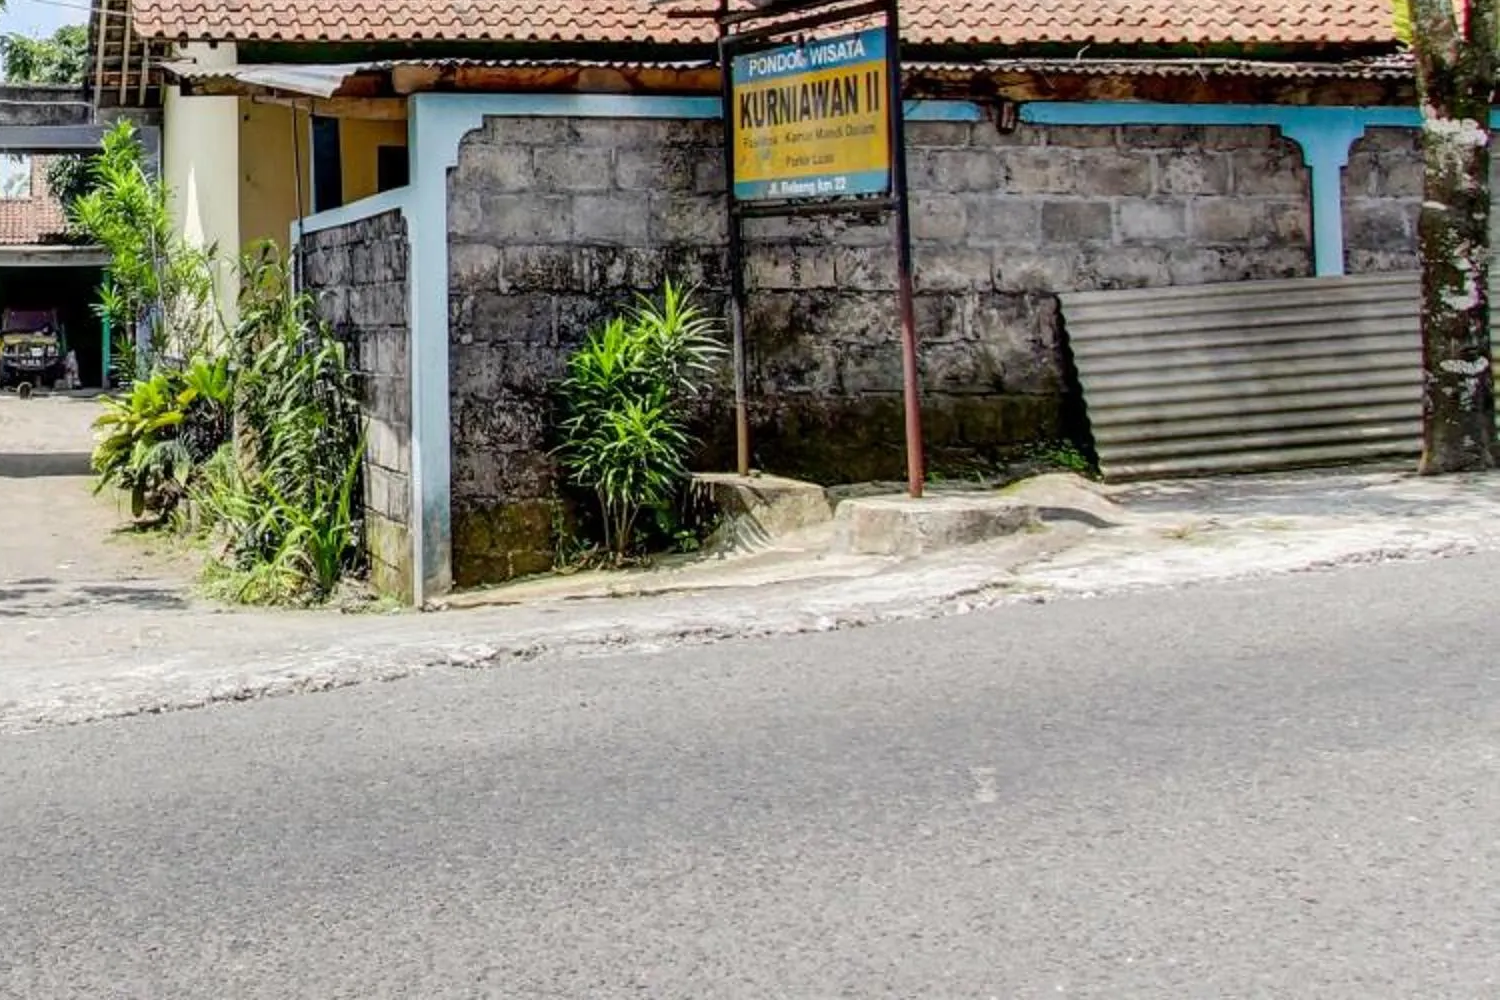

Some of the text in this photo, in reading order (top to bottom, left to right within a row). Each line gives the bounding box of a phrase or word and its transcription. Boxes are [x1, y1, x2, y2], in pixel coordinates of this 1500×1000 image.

[749, 39, 866, 76] PONDOK WISATA
[740, 70, 879, 129] KURNIAWAN II
